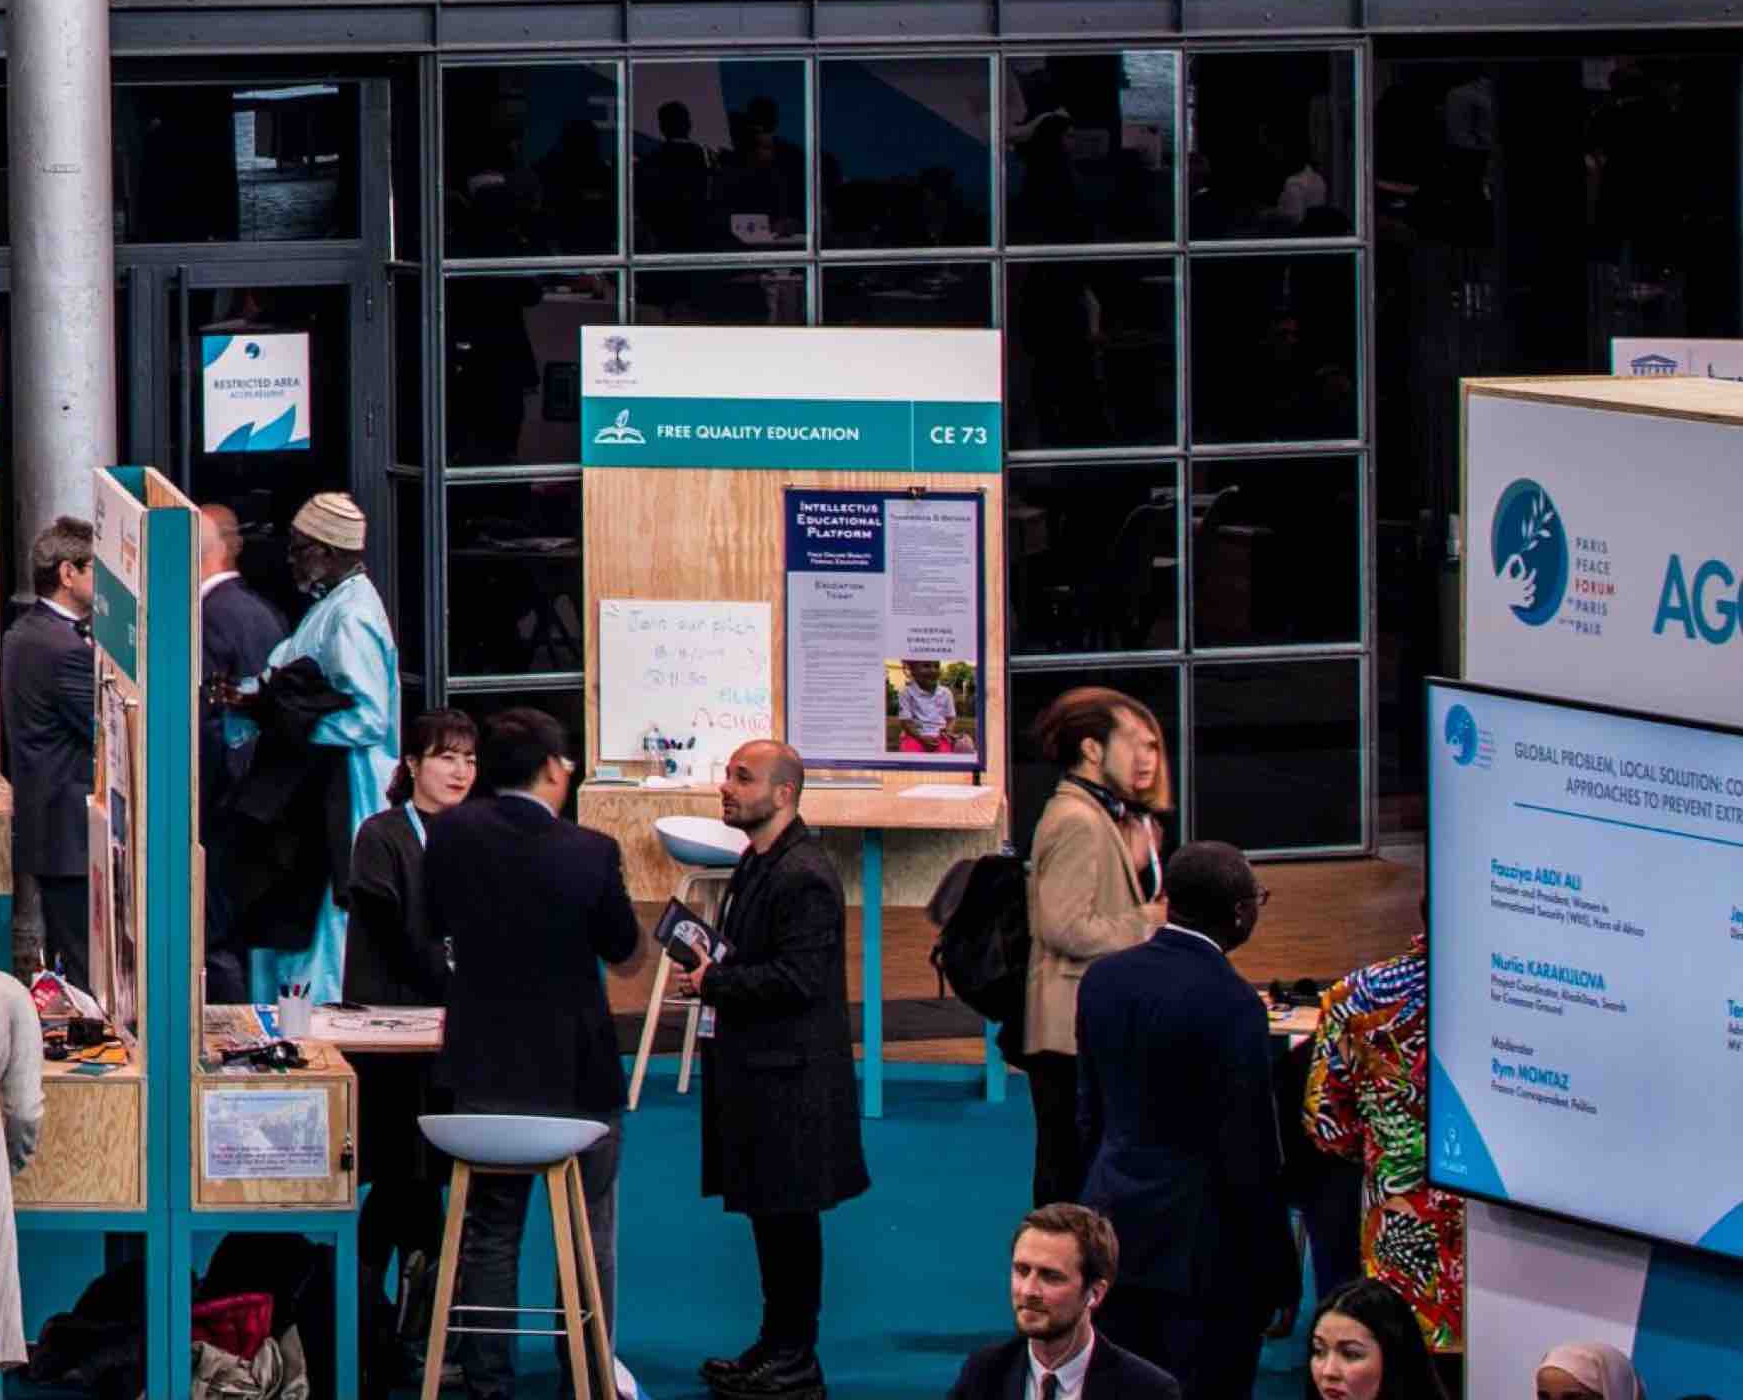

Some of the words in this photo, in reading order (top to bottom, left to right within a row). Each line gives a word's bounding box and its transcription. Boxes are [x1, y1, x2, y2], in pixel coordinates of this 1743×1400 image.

[214, 379, 271, 389] RESTRICTED
[275, 378, 300, 387] AREA
[657, 425, 691, 439] FREE
[696, 425, 763, 441] QUALITY
[767, 426, 860, 441] EDUCATION
[930, 426, 956, 444] CE
[961, 427, 987, 445] 73
[1575, 537, 1608, 555] PARIS
[1575, 558, 1611, 576] PEACE
[1575, 579, 1614, 596] FORUM
[1575, 598, 1608, 616] PARIS
[1652, 553, 1743, 645] AG
[1575, 618, 1602, 636] PAIX
[1514, 741, 1558, 765] GLOBAL
[1561, 751, 1616, 777] PROBLEM,
[1619, 761, 1656, 783] LOCAL
[1659, 767, 1723, 793] SOLUTION:
[1566, 778, 1640, 806] APPROACHES
[1643, 790, 1660, 809] TO
[1663, 794, 1713, 819] PREVENT
[1518, 1064, 1570, 1090] MOMTAZ
